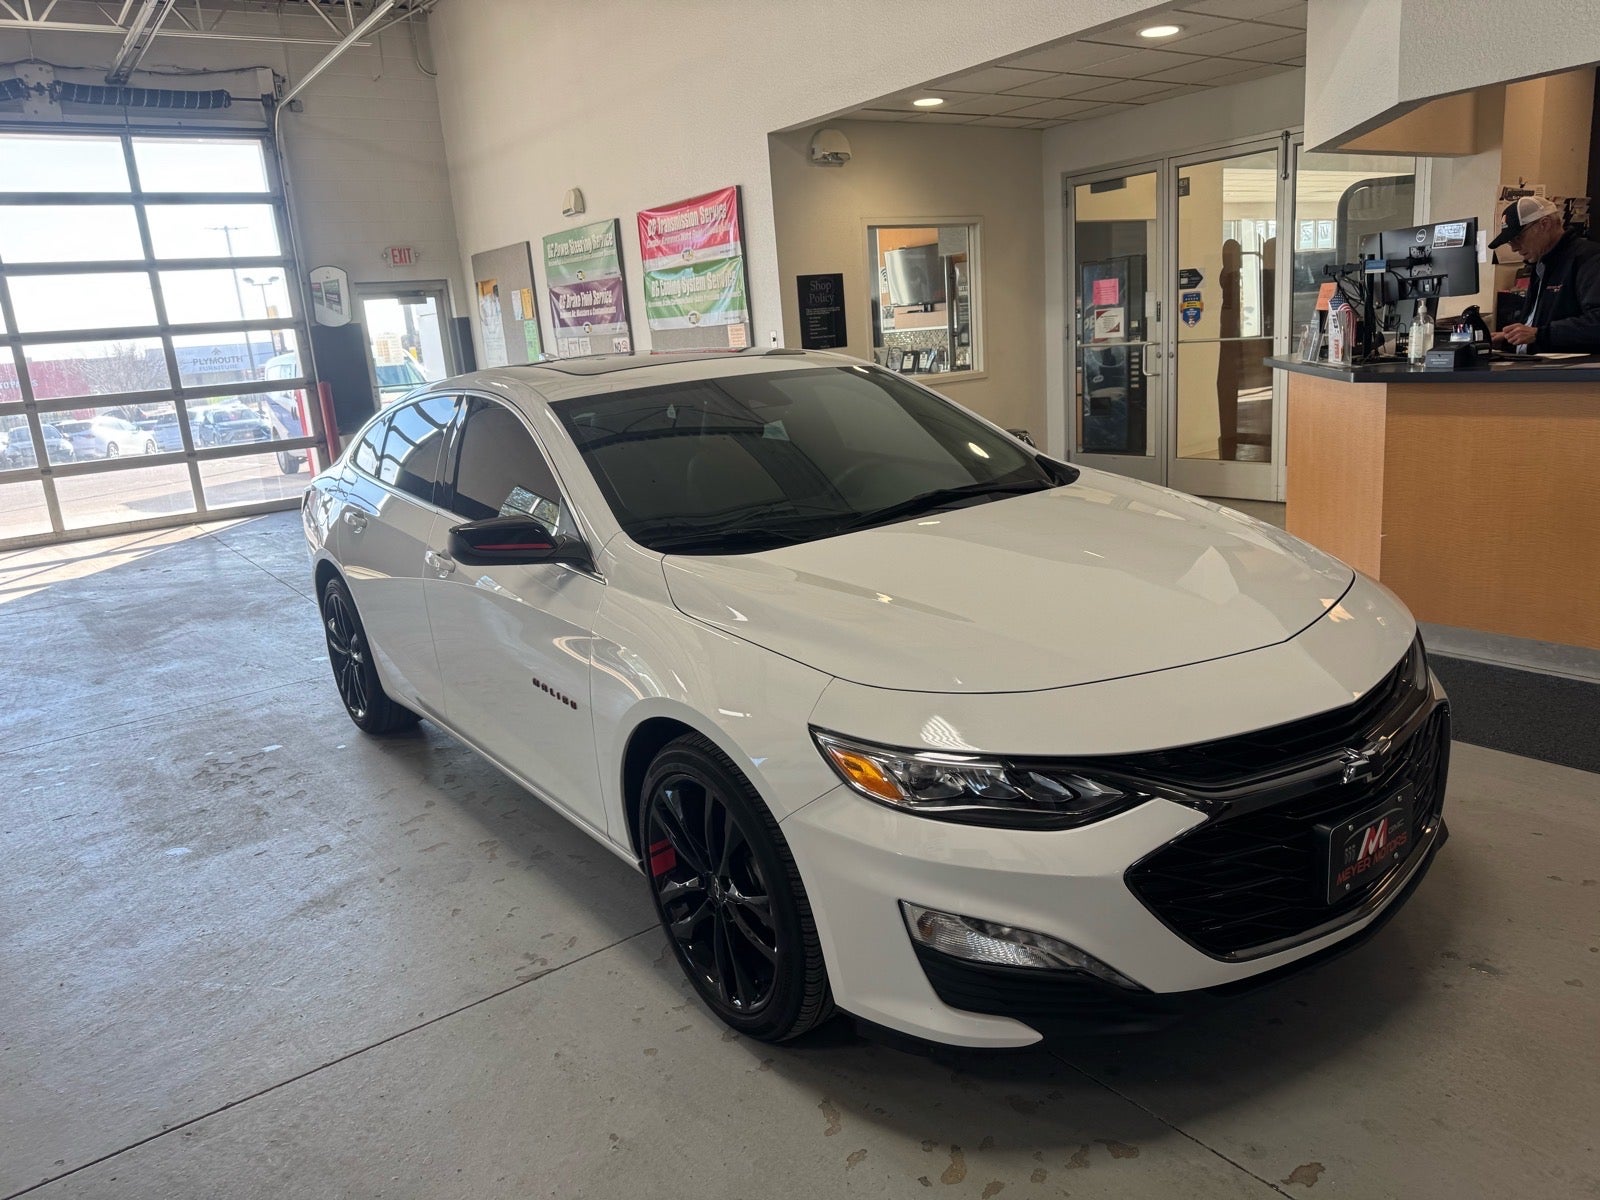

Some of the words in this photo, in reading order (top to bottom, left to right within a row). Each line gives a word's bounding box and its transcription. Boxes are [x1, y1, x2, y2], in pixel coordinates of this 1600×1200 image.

[658, 209, 698, 233] Transmission
[699, 202, 727, 223] Service
[391, 247, 412, 264] EXIT
[555, 241, 569, 257] Power
[569, 237, 592, 255] Steering
[592, 232, 613, 250] Service
[660, 279, 681, 297] Cooling
[681, 275, 706, 296] System
[707, 270, 736, 290] Service
[810, 279, 832, 293] Shop
[566, 292, 581, 308] Brake
[581, 290, 592, 307] Fluid
[592, 288, 613, 305] Service
[809, 293, 835, 305] Policy
[192, 355, 243, 367] PLYMOUTH
[532, 677, 578, 710] MALIBU
[1357, 817, 1389, 861] M
[1336, 857, 1371, 886] MEYER
[1372, 831, 1408, 865] MOTORS
